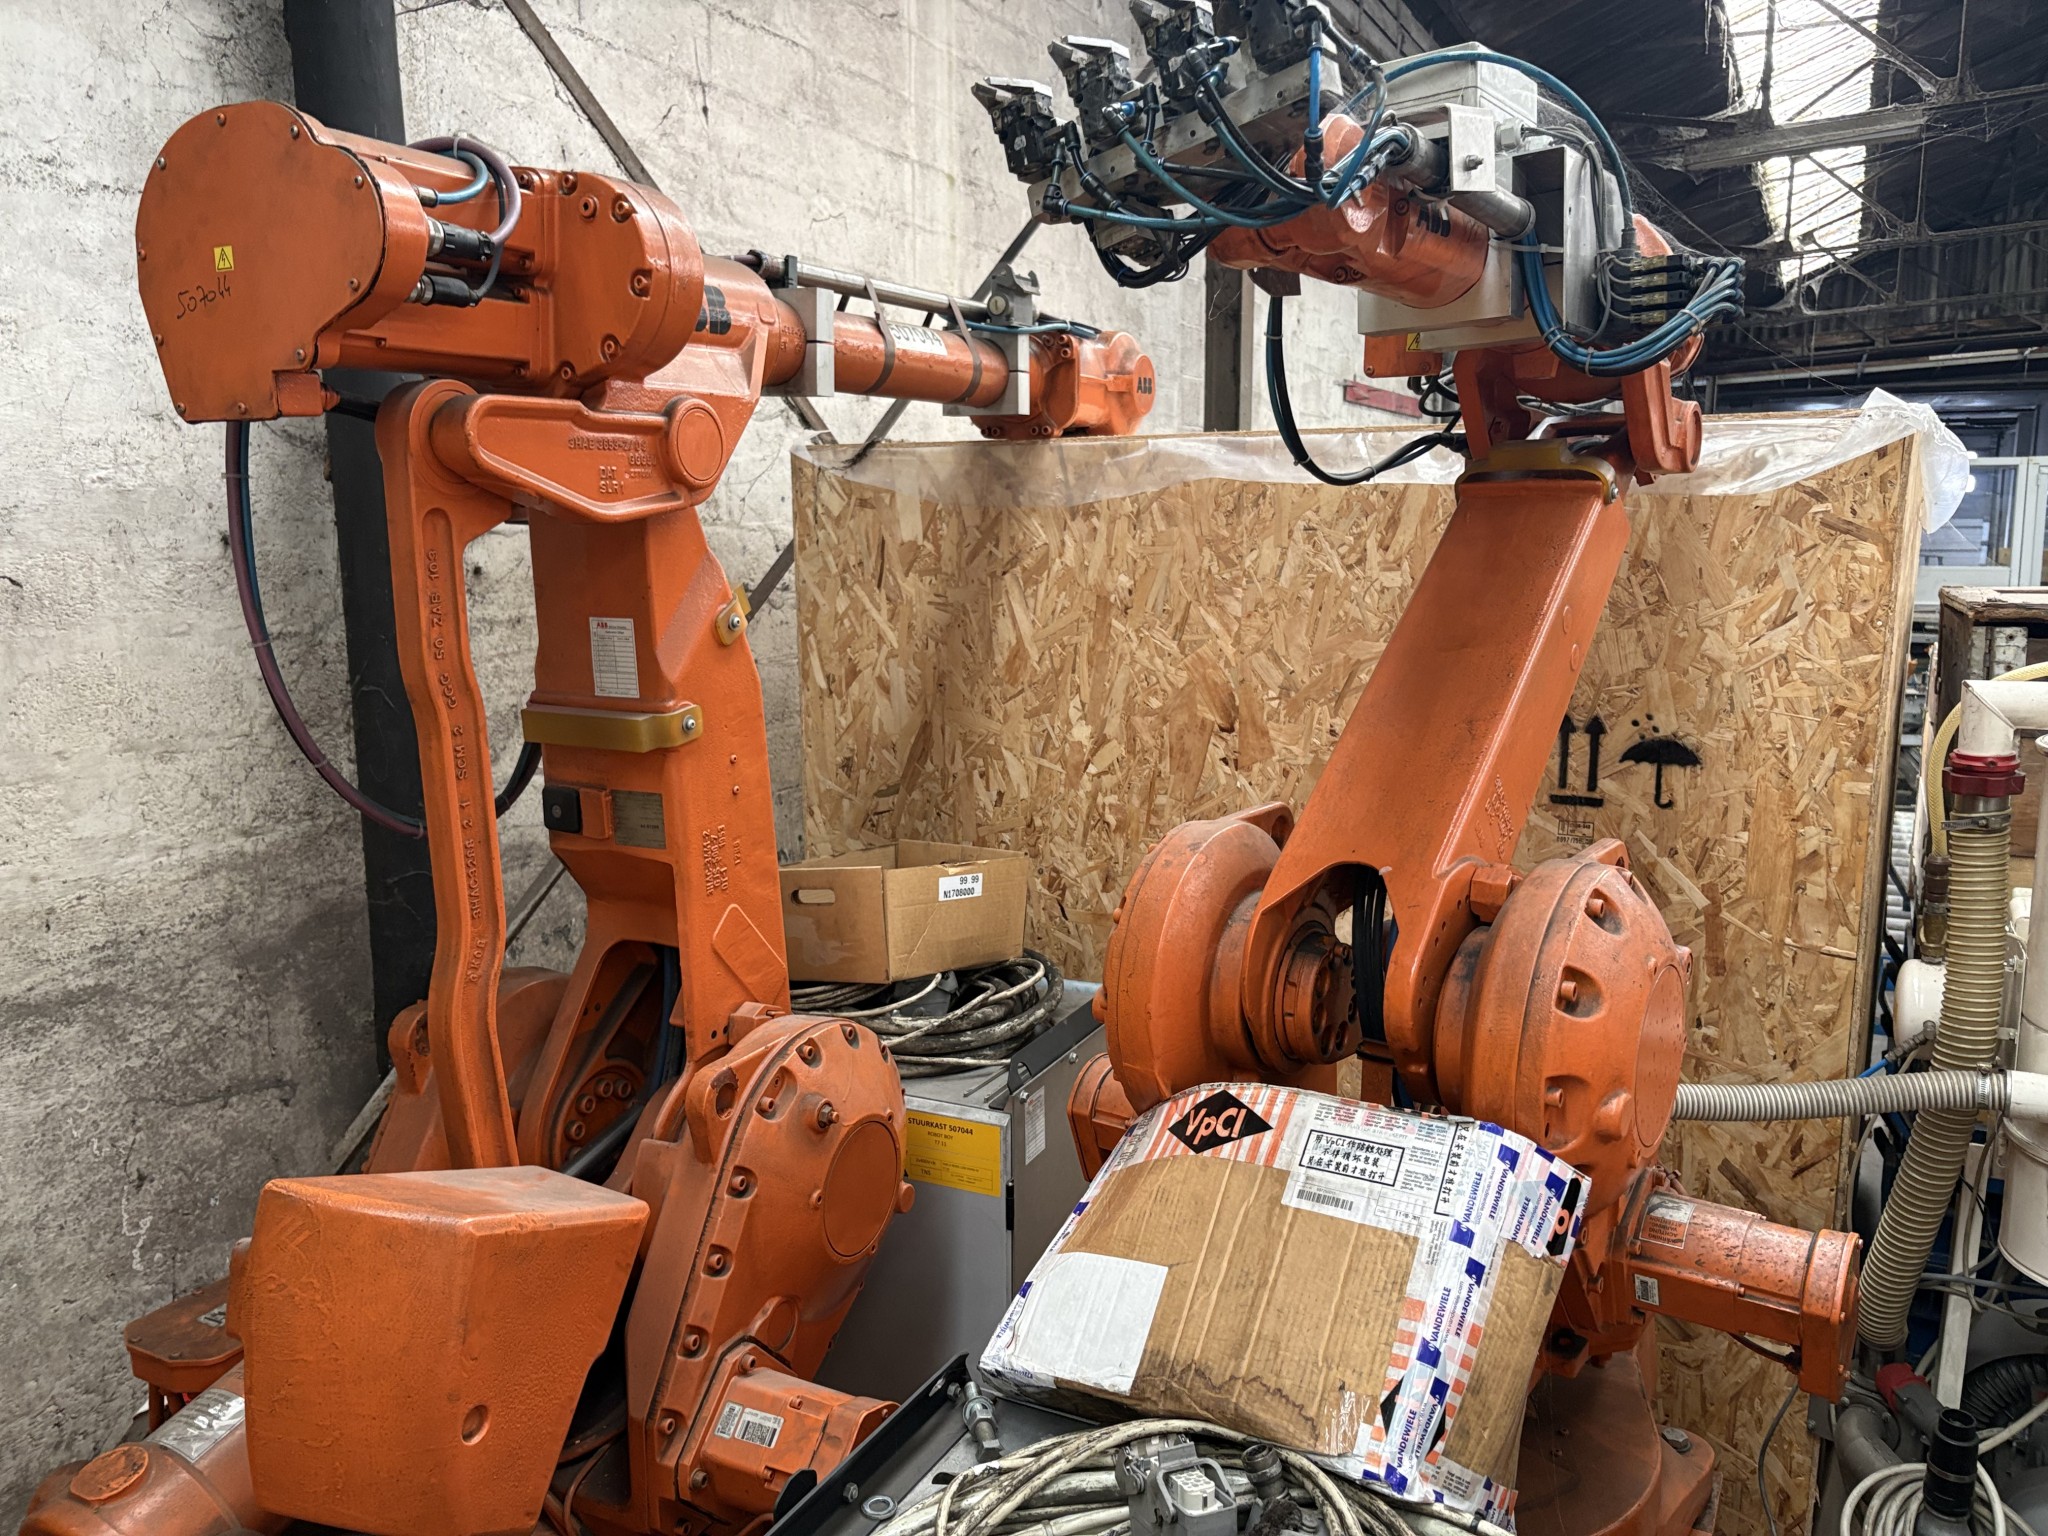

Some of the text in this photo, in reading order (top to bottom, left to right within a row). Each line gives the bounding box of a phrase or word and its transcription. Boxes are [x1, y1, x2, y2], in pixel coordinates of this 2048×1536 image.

[177, 274, 231, 319] 507044
[1136, 376, 1152, 395] ABB
[908, 1117, 973, 1135] STUURKAST 507044
[1185, 1107, 1247, 1145] VpCI
[1462, 1171, 1483, 1222] VANDEWIELE
[1489, 1168, 1509, 1220] VANDEWIELE
[1511, 1196, 1531, 1241] ANDEWIELE
[1530, 1195, 1554, 1246] VANDEWIELE
[1430, 1287, 1451, 1342] VANDEWIELE
[1454, 1283, 1475, 1338] VANDEWIELE
[1396, 1408, 1417, 1468] VANDEWIELE
